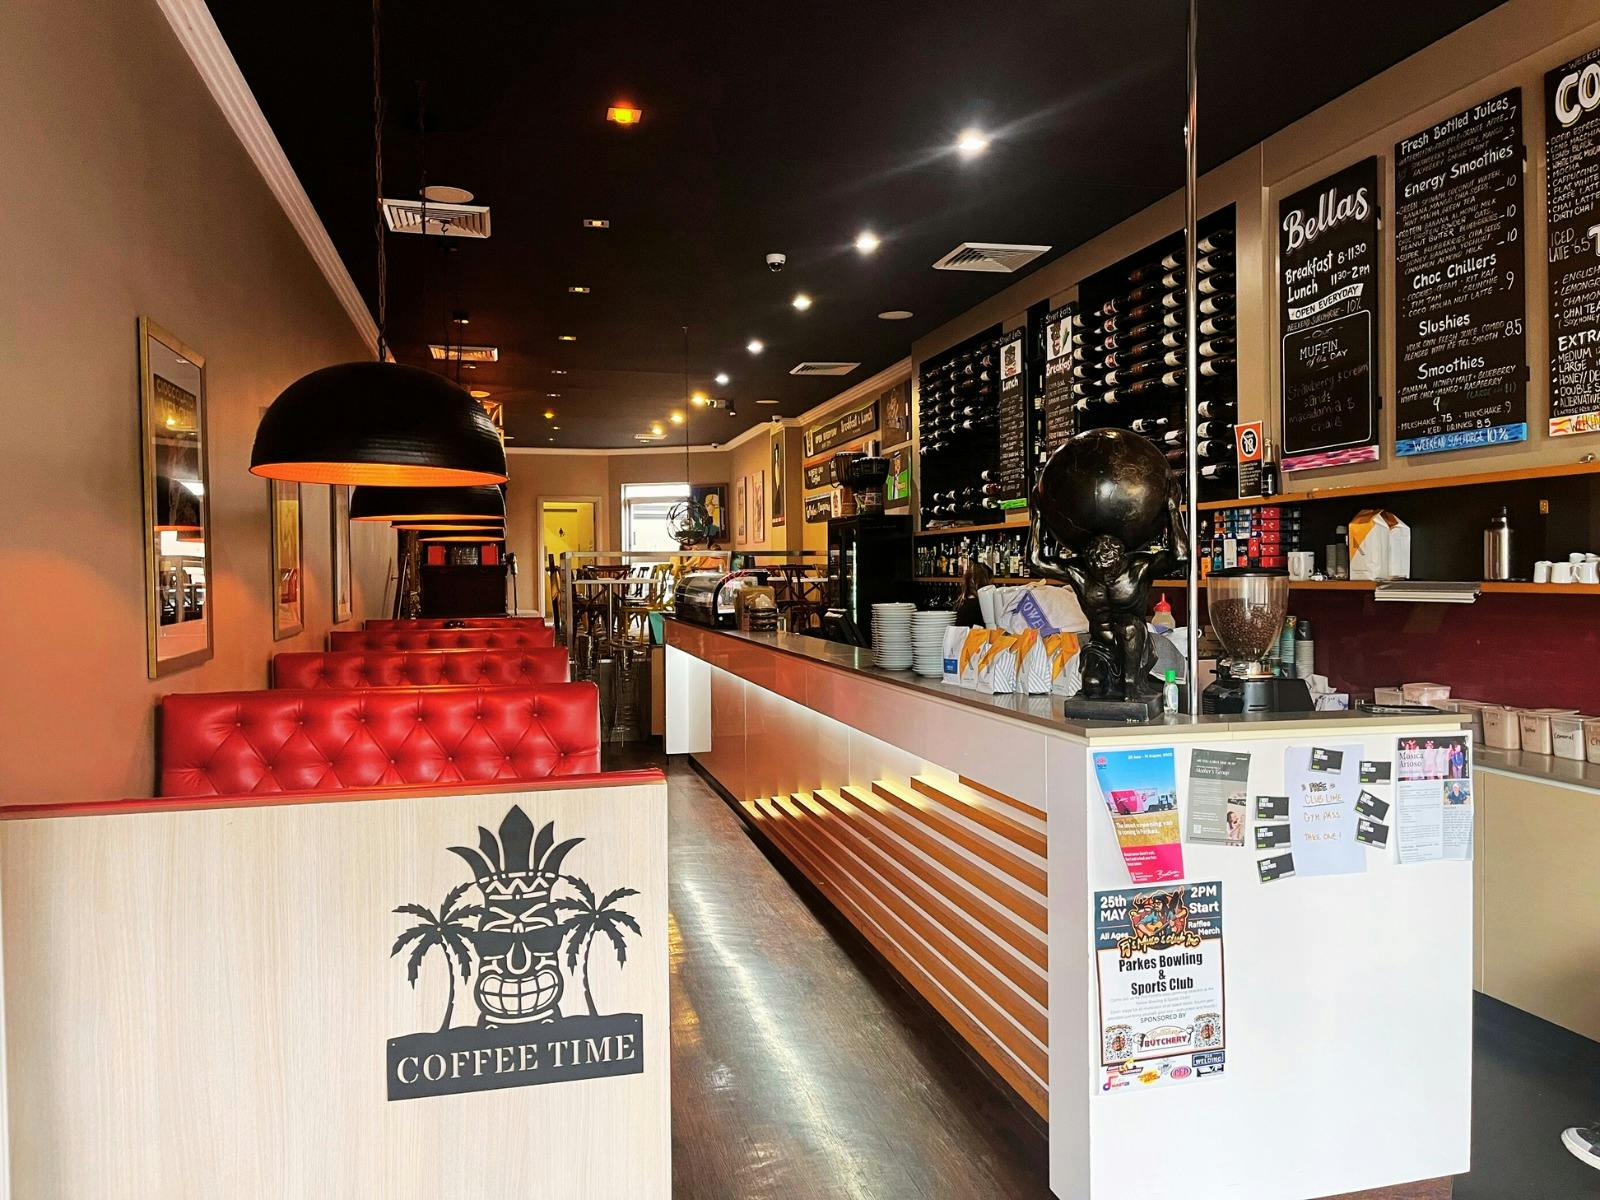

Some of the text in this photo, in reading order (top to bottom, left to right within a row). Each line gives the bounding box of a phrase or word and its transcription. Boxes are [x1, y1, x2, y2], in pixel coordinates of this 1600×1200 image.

[1401, 133, 1428, 155] Fresh
[1434, 112, 1468, 139] Bottled
[1474, 97, 1508, 120] Juices
[1405, 173, 1446, 197] Energy
[1450, 145, 1513, 178] Smoothies
[1553, 162, 1579, 178] MOCHA
[1507, 174, 1516, 185] 10
[1554, 173, 1599, 195] FLAT WHITE
[1580, 181, 1600, 194] LATT
[1507, 204, 1516, 217] 10
[1553, 201, 1571, 213] CHAI
[1554, 201, 1593, 222] DIRTY CHAI
[1283, 187, 1369, 253] Bellas
[1507, 229, 1517, 242] 10
[1551, 228, 1574, 247] ICED
[1285, 250, 1333, 284] Breakfast
[1413, 254, 1496, 289] Choc Chillers
[1506, 271, 1514, 290] 9
[1287, 279, 1317, 303] Lunch
[1470, 286, 1493, 298] LATTE
[1295, 285, 1358, 318] OPEN EVERYDAY
[1347, 299, 1361, 314] 10%
[1564, 305, 1582, 319] CHAI
[1419, 314, 1470, 336] Slushies
[1300, 339, 1338, 361] MUFFIN
[1558, 347, 1592, 363] MEDIUM
[1046, 355, 1073, 377] Breakfast
[1306, 349, 1347, 368] of the DAY
[1560, 360, 1587, 372] LARGE
[1418, 356, 1484, 379] Smoothies
[1003, 377, 1018, 392] Lunch
[1560, 384, 1591, 396] DOUBLE
[1427, 420, 1472, 434] ICED DRINKS
[1304, 811, 1320, 822] GYM
[1191, 885, 1216, 898] 2PM
[1100, 895, 1126, 908] 25th
[1189, 901, 1219, 914] Start
[1100, 909, 1126, 922] MAY
[1188, 920, 1211, 928] Raffles
[1198, 927, 1220, 935] Merch
[1100, 932, 1110, 940] All
[1119, 953, 1202, 972] Parkes Bowling
[1159, 969, 1165, 980] &
[1131, 977, 1193, 995] Sports Club
[1140, 1013, 1177, 1023] SPONSORED
[1145, 1035, 1187, 1048] BUTCHERY
[397, 1034, 635, 1084] COFFEE TIME
